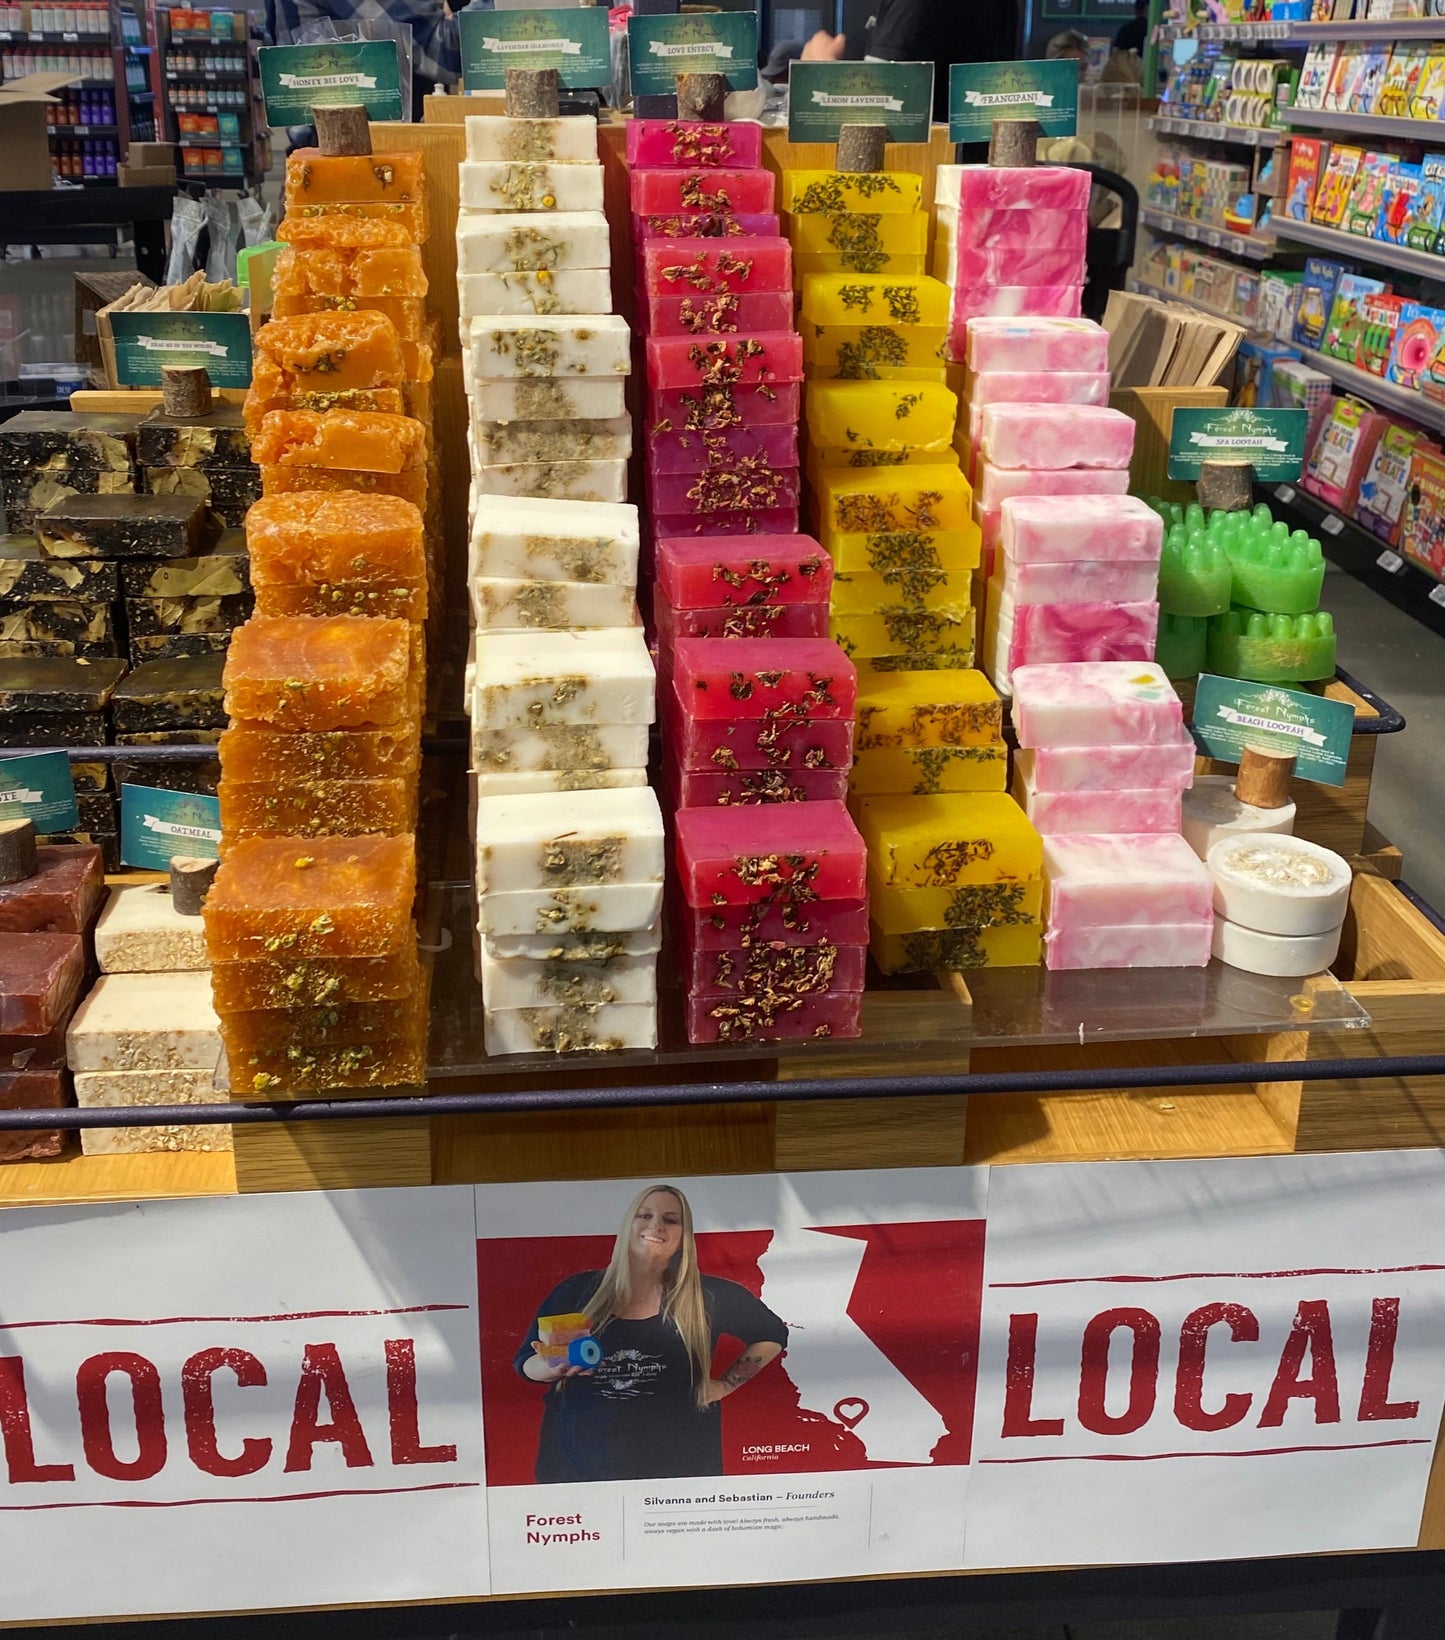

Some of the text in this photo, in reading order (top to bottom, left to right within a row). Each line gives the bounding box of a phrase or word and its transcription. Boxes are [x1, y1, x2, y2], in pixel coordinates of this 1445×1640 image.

[667, 45, 715, 55] LOVE ENERGY
[293, 78, 321, 87] HONEY
[339, 75, 360, 83] LOVE
[981, 93, 1038, 105] FRANGIPANI
[1203, 422, 1277, 436] Forest Nymphs
[1233, 698, 1315, 726] Forest Nymphs
[1236, 715, 1264, 728] BEACH
[170, 825, 212, 839] OATMEAL
[1000, 1297, 1420, 1439] LOCAL
[0, 1338, 458, 1484] LOCAL
[742, 1443, 810, 1455] LONG BEACH
[742, 1454, 779, 1462] California
[644, 1496, 692, 1506] Silvanna
[694, 1494, 716, 1504] and
[718, 1492, 773, 1503] Sebastian
[786, 1490, 835, 1500] Founders
[526, 1513, 582, 1527] Forest
[740, 1517, 762, 1525] Always
[781, 1515, 804, 1523] always
[526, 1529, 601, 1546] Nymphs
